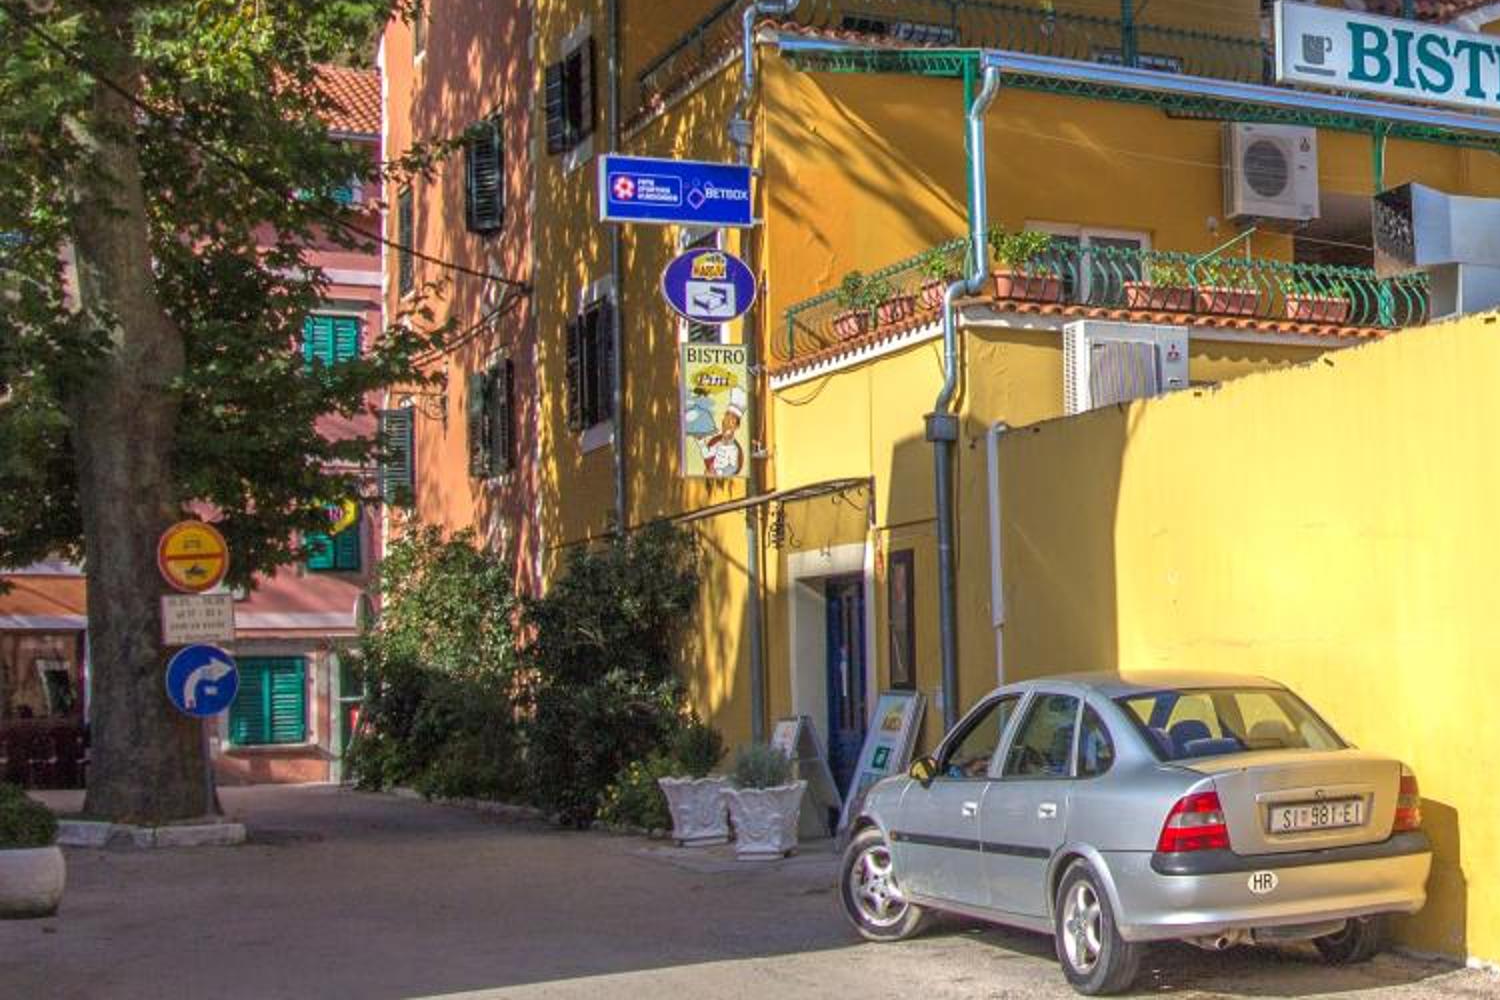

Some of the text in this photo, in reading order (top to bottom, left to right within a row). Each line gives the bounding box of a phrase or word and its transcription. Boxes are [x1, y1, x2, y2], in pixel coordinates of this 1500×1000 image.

[687, 347, 745, 365] BISTRO
[1283, 809, 1297, 829] SI
[1253, 873, 1273, 890] HR
